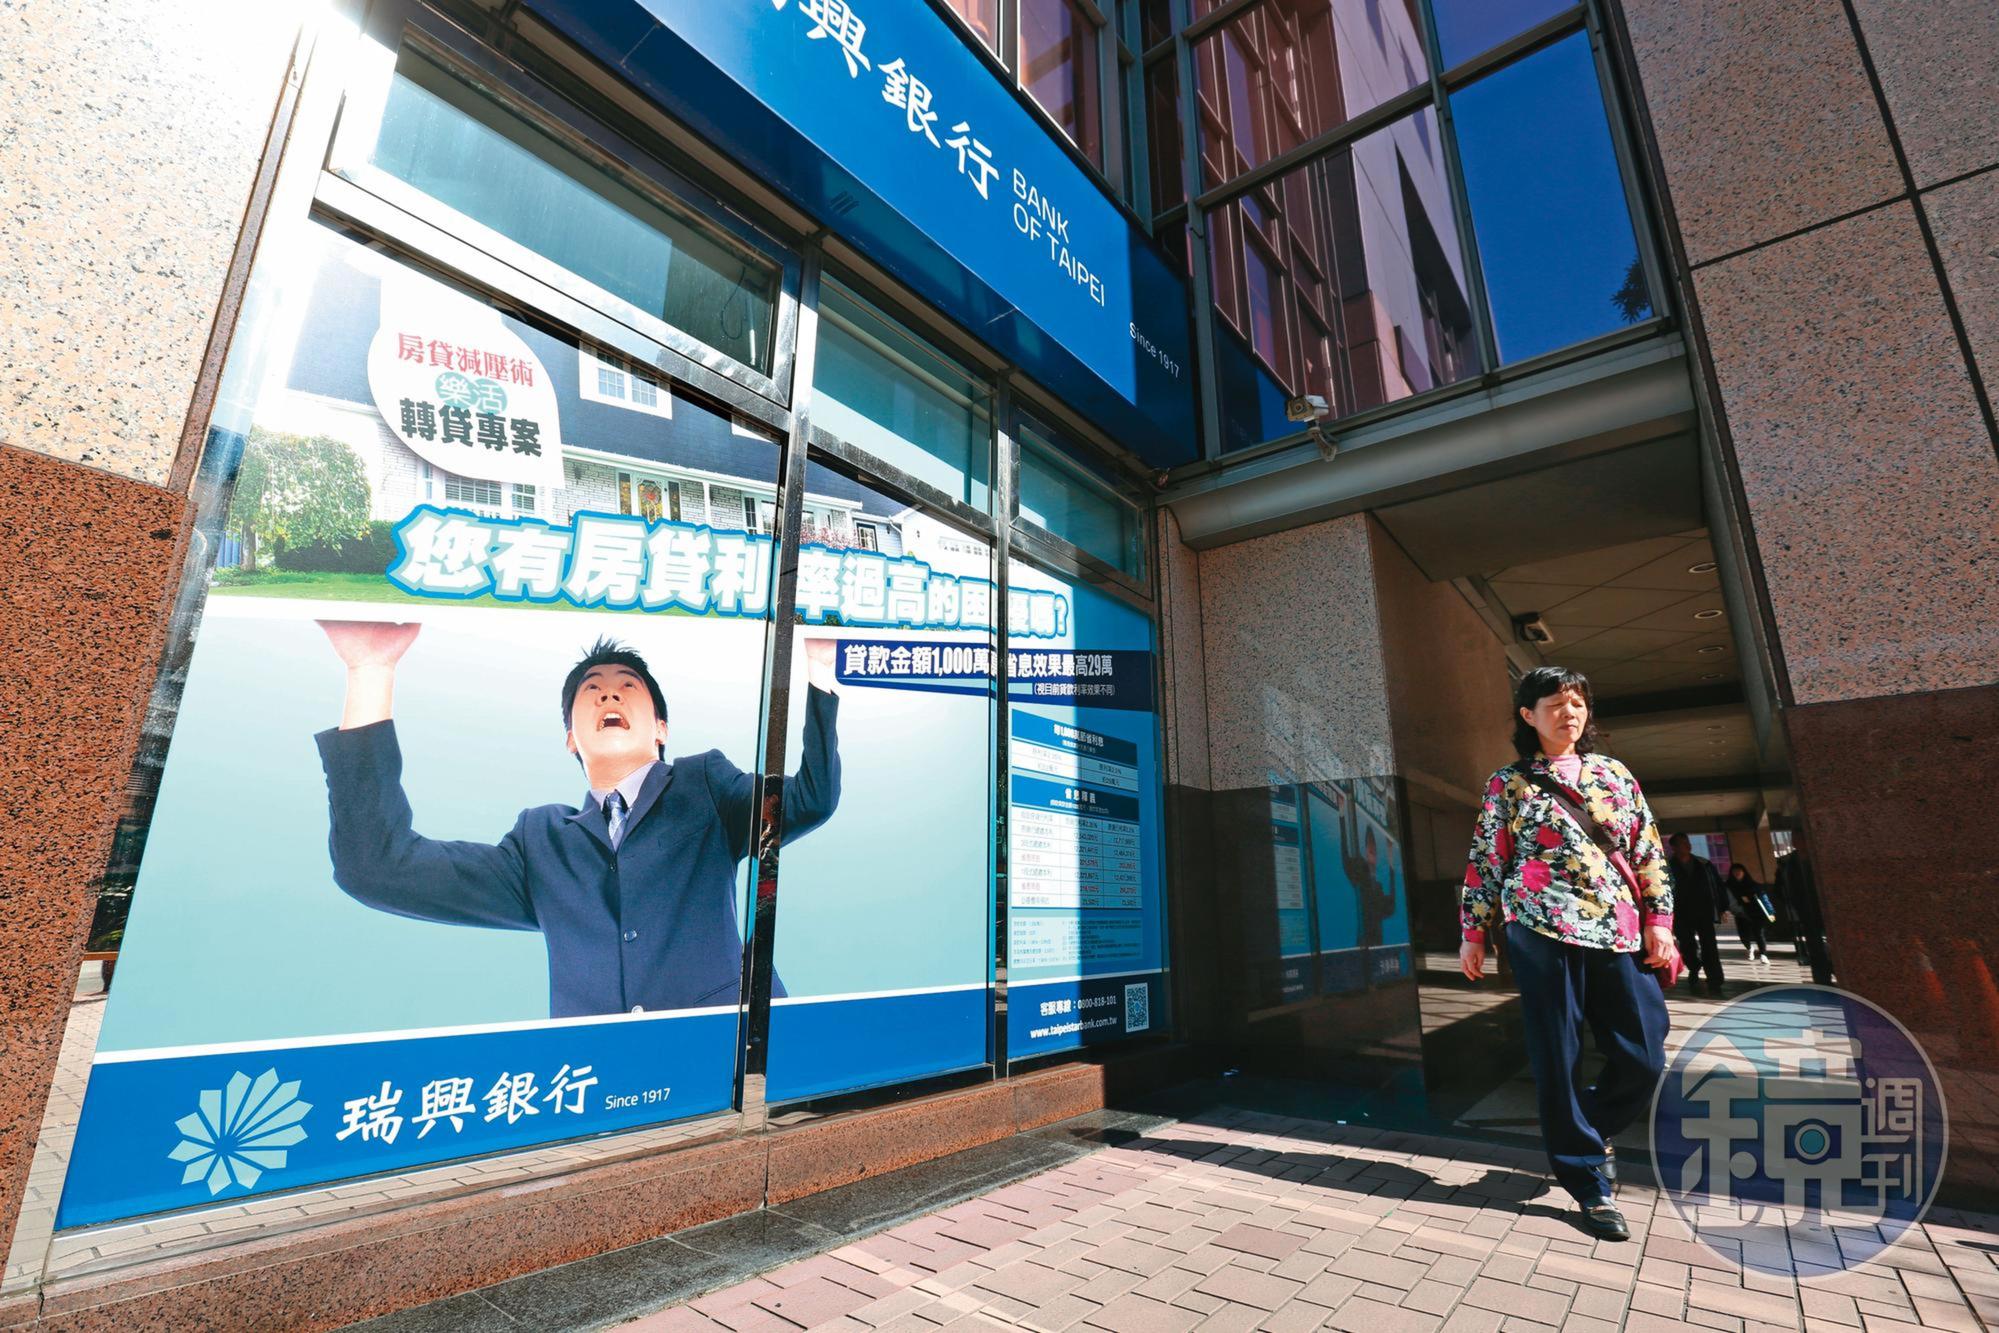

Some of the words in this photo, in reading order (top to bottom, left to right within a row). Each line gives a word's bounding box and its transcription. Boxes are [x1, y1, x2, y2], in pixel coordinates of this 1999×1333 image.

[772, 0, 999, 200] 興銀行
[1013, 168, 1069, 244] BANK
[1013, 203, 1042, 241] OF
[1047, 237, 1105, 307] TAIPEI
[398, 332, 534, 388] 房貸減壓術
[1129, 321, 1157, 359] Since
[1159, 350, 1180, 379] 1917
[437, 373, 504, 412] 樂活
[400, 397, 542, 458] 轉貸專案
[1030, 1016, 1118, 1039] www.taipeistarbank.com.tw
[336, 1063, 599, 1145] 瑞興銀行
[605, 1094, 638, 1110] Since
[641, 1087, 671, 1105] 1917
